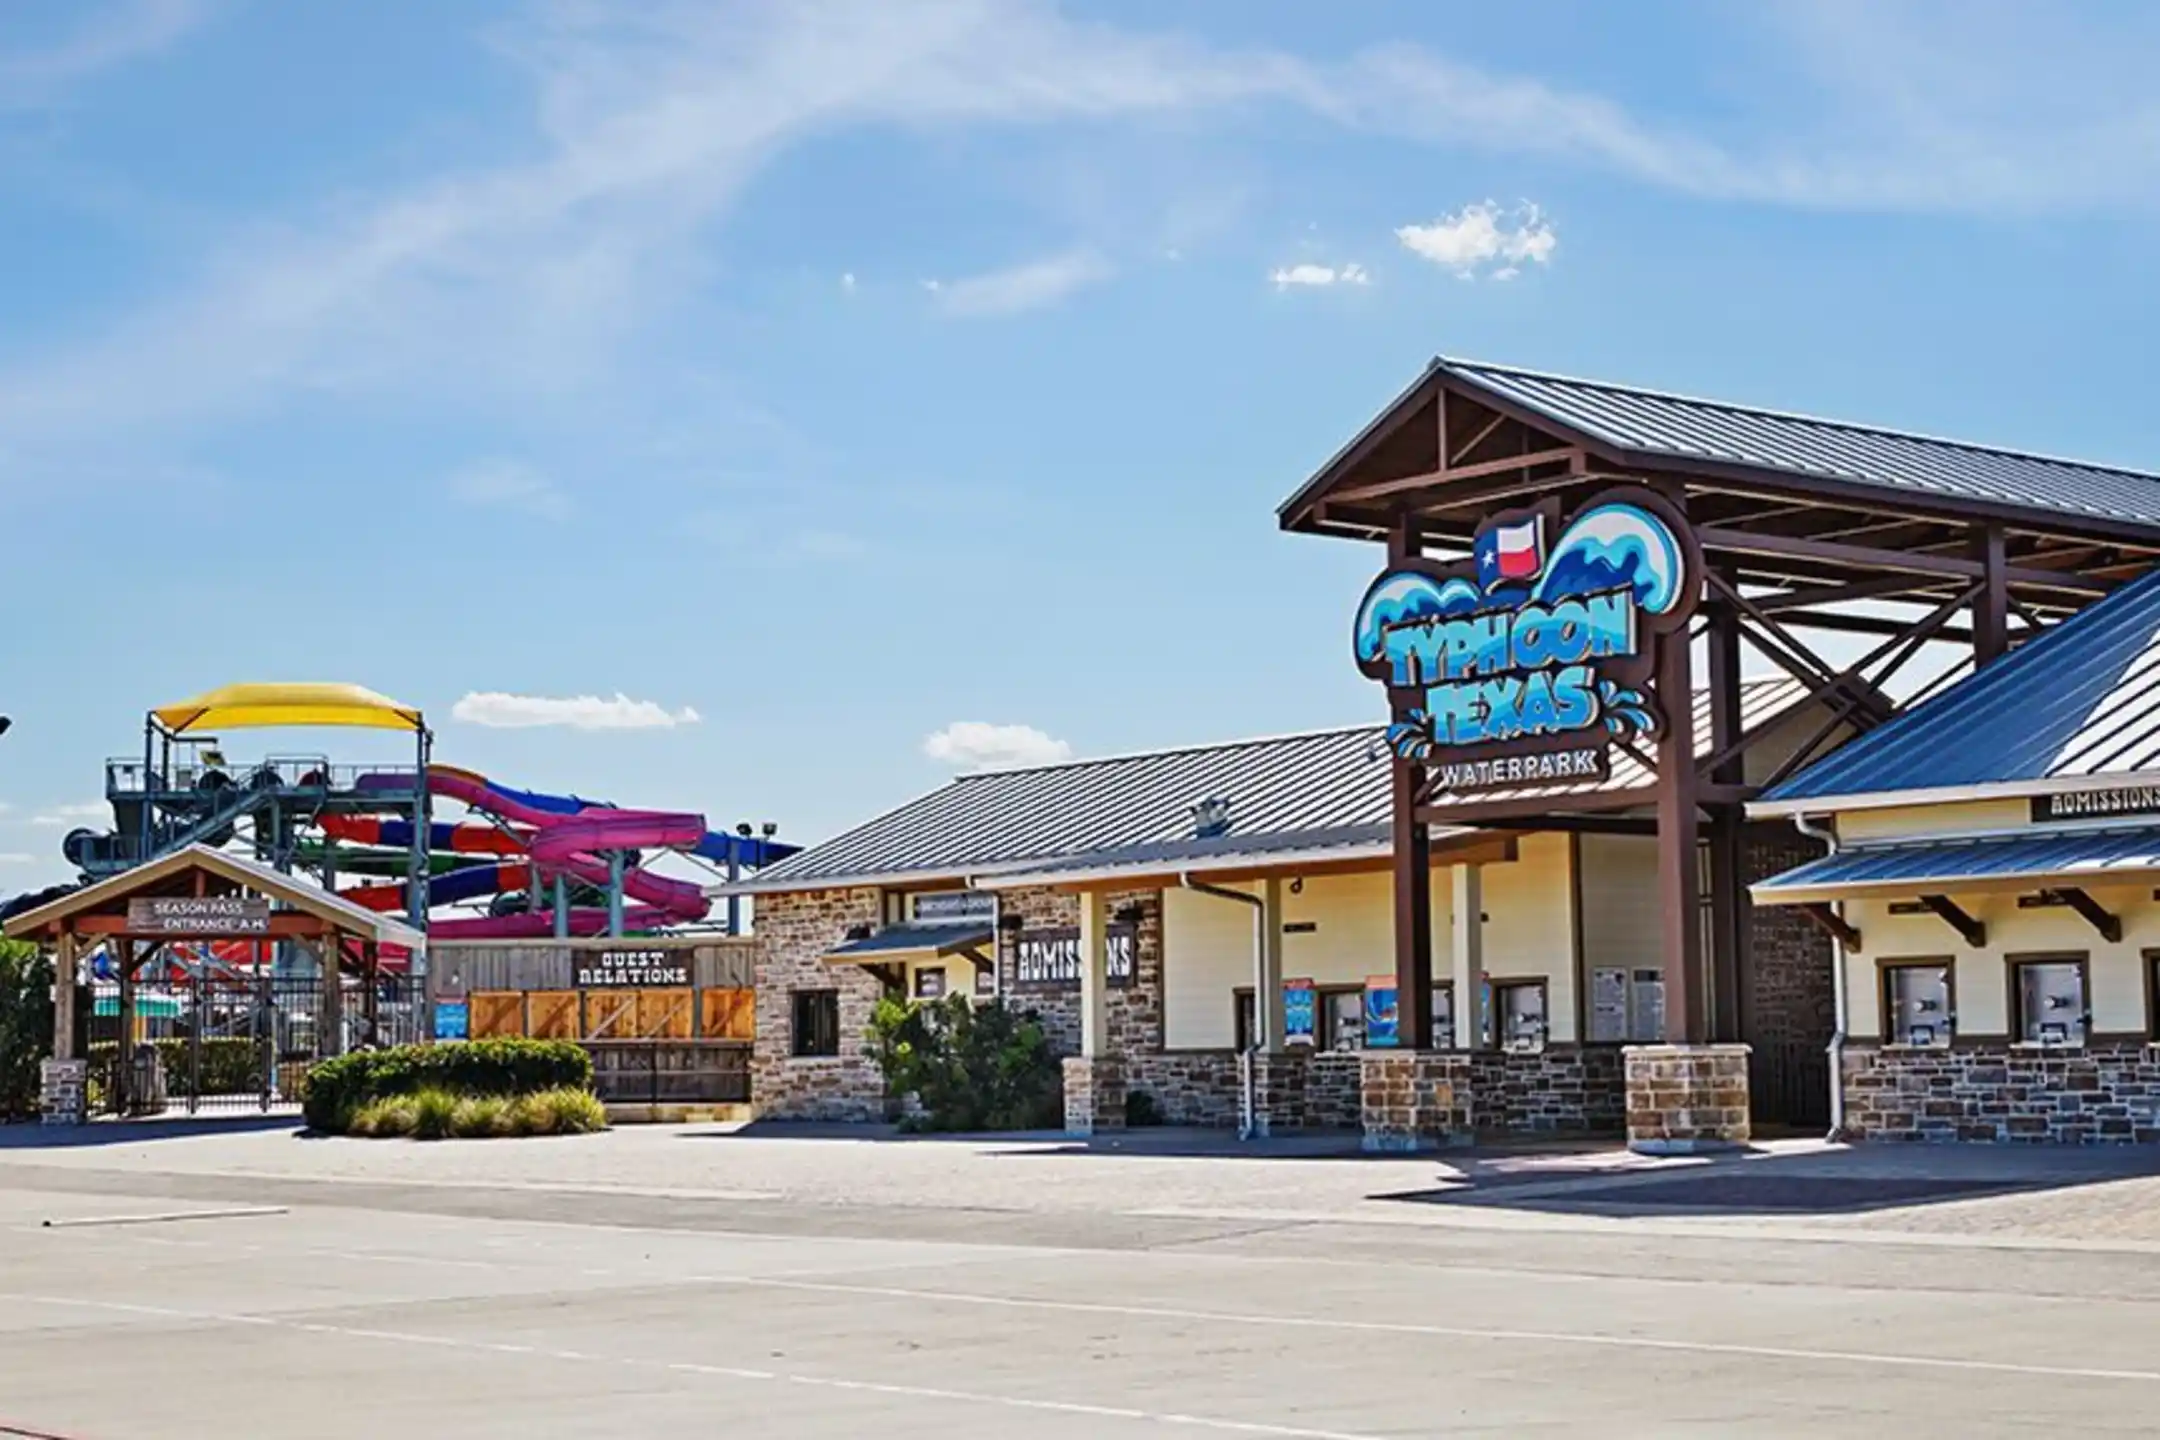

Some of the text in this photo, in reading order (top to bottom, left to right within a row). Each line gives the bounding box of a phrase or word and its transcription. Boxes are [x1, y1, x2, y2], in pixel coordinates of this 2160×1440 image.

[1383, 588, 1637, 686] TYPHOON
[1426, 666, 1598, 745] TEXAS
[1442, 750, 1598, 787] WATERPARK
[154, 901, 243, 915] SEASON PASS
[163, 917, 237, 930] ENTRANCE
[602, 952, 665, 967] GUEST
[579, 968, 687, 984] RELATIONS
